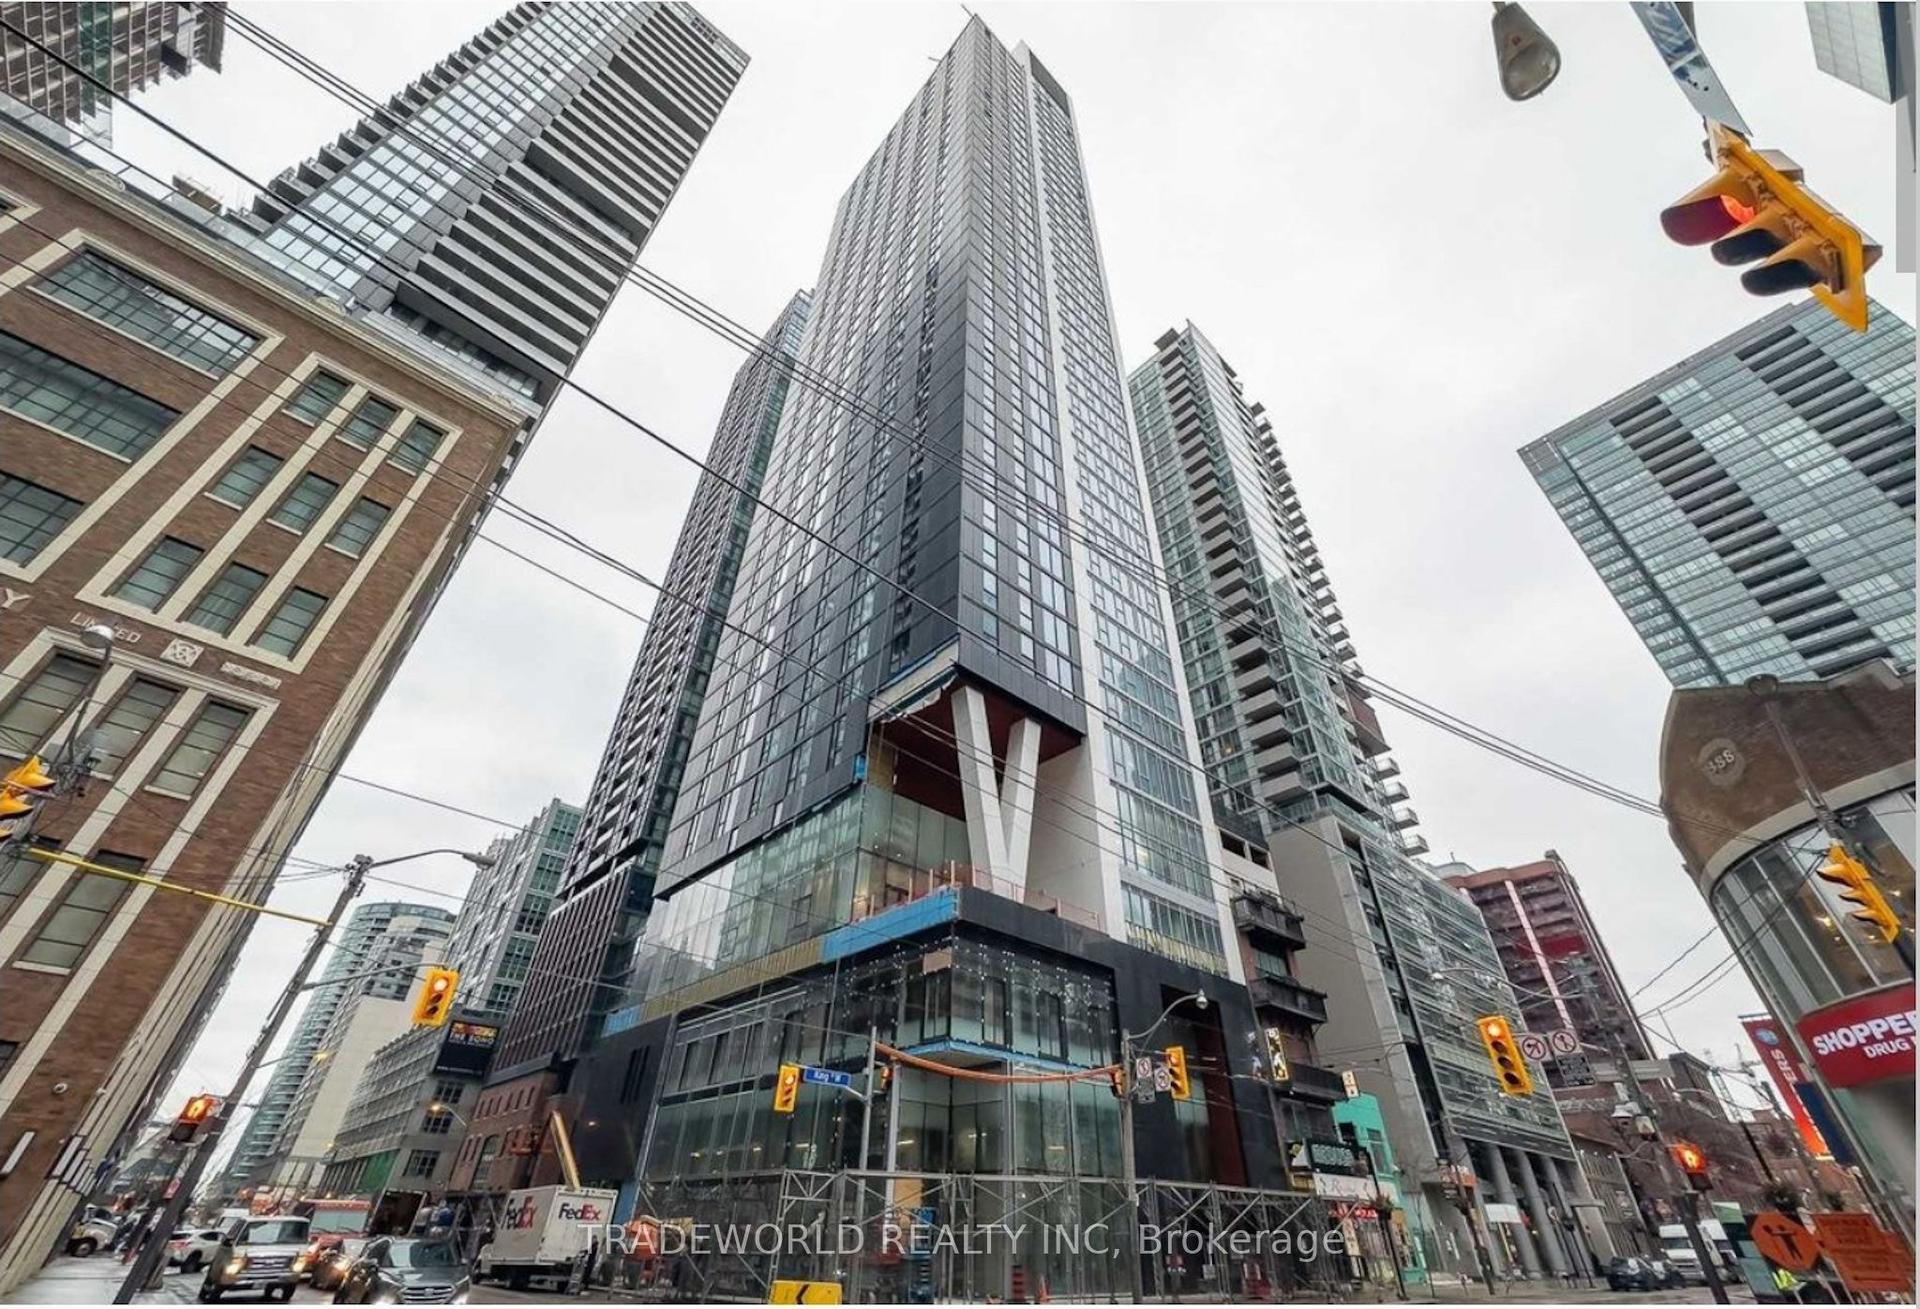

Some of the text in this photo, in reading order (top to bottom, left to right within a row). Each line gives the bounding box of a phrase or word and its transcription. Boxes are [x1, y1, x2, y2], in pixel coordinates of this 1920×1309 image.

[69, 612, 142, 643] LIED
[1862, 1037, 1912, 1059] DRUG
[558, 1202, 601, 1221] FedEx
